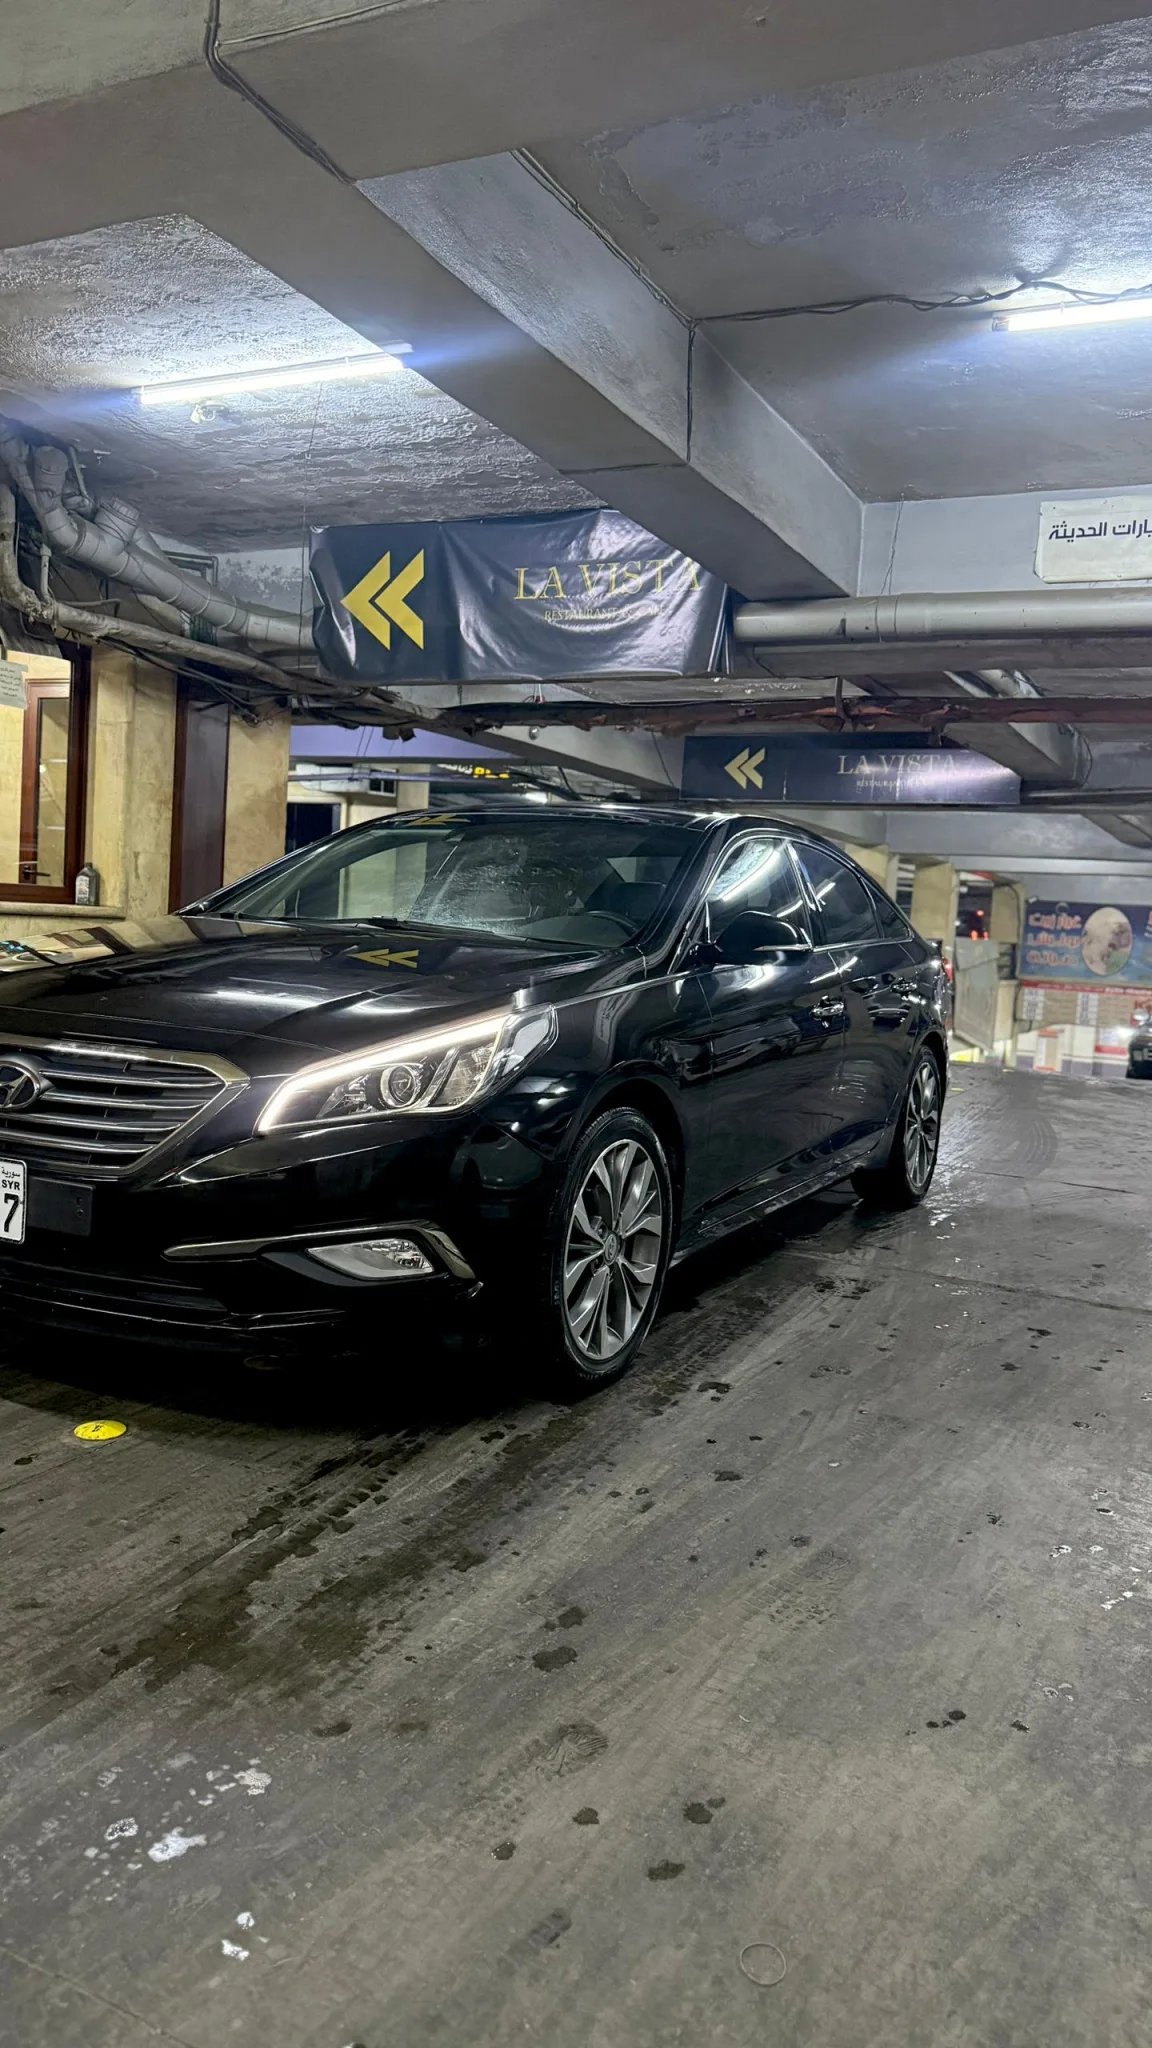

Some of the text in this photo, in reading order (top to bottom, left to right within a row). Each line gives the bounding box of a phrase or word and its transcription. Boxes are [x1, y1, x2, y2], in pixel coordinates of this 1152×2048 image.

[1048, 520, 1108, 543] الحديثة
[513, 557, 703, 601] LA VISTA
[837, 755, 958, 775] LA VISTA
[1, 1166, 21, 1179] سورية
[1, 1179, 21, 1191] SYR
[4, 1192, 19, 1233] 7
